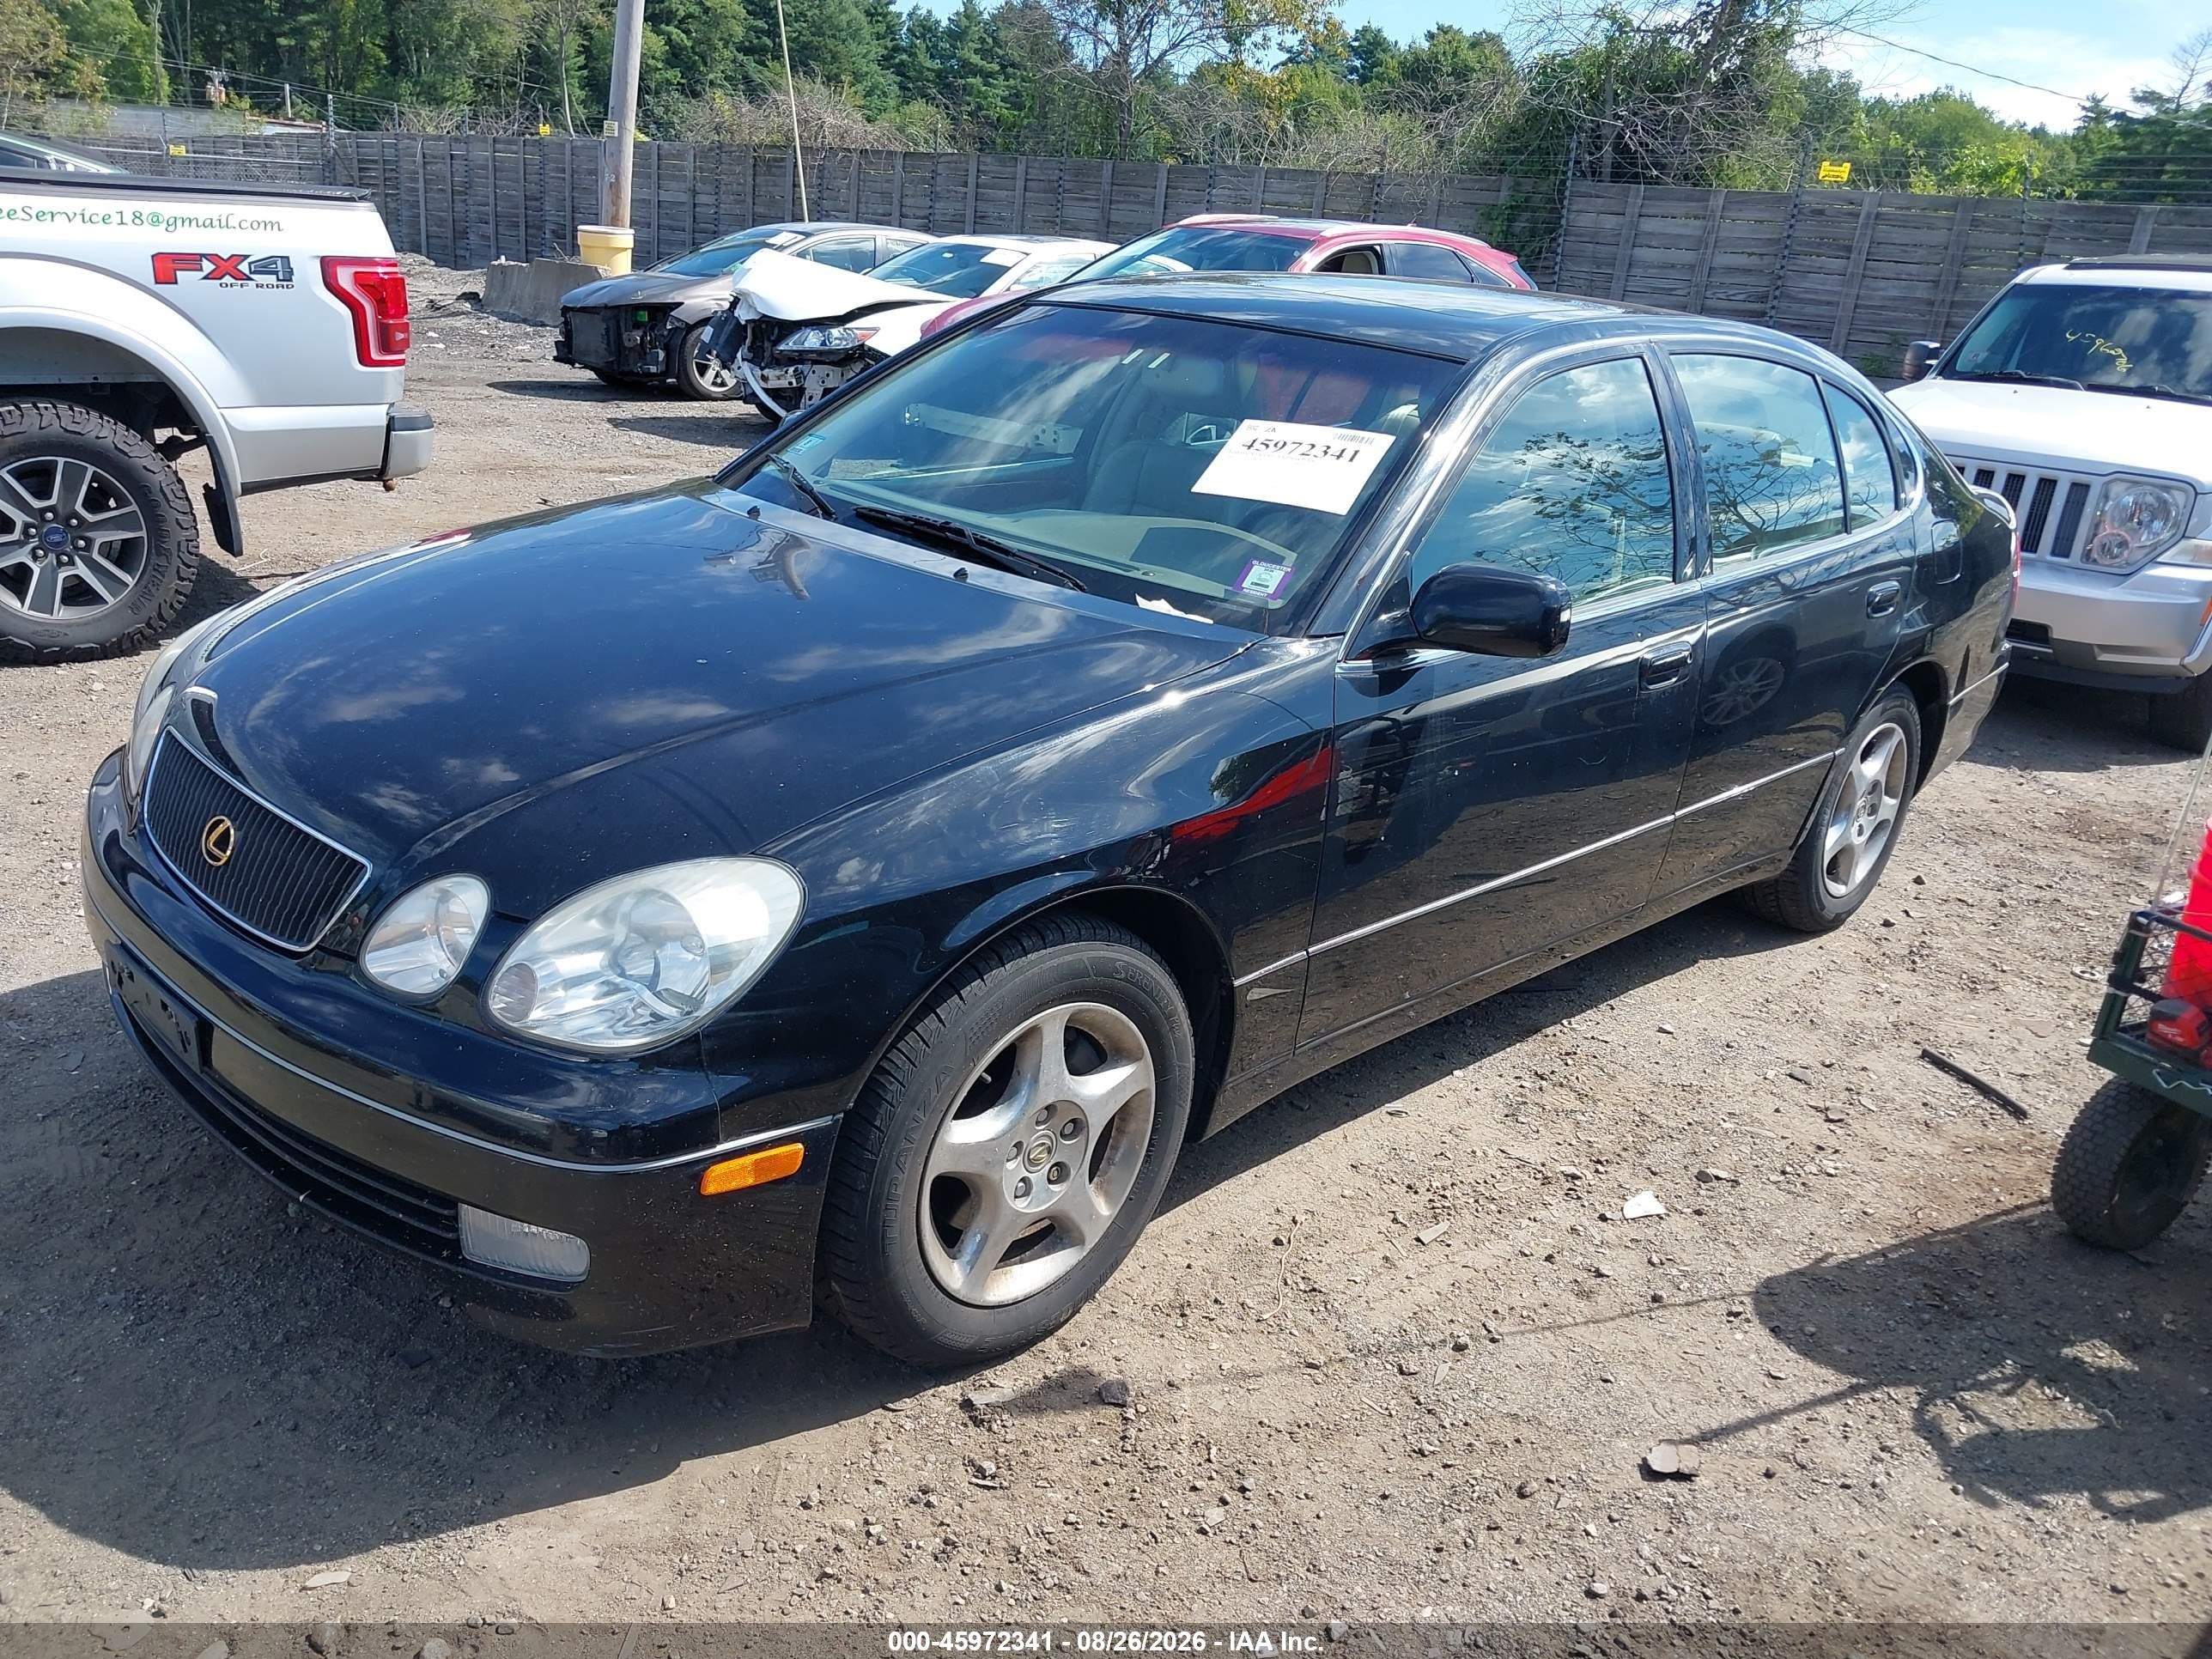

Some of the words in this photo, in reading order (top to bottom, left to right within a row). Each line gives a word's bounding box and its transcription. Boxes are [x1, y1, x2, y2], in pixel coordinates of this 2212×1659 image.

[151, 252, 294, 284] FX4
[1242, 436, 1360, 464] 45972341
[1251, 560, 1292, 573] GLOUCESTER
